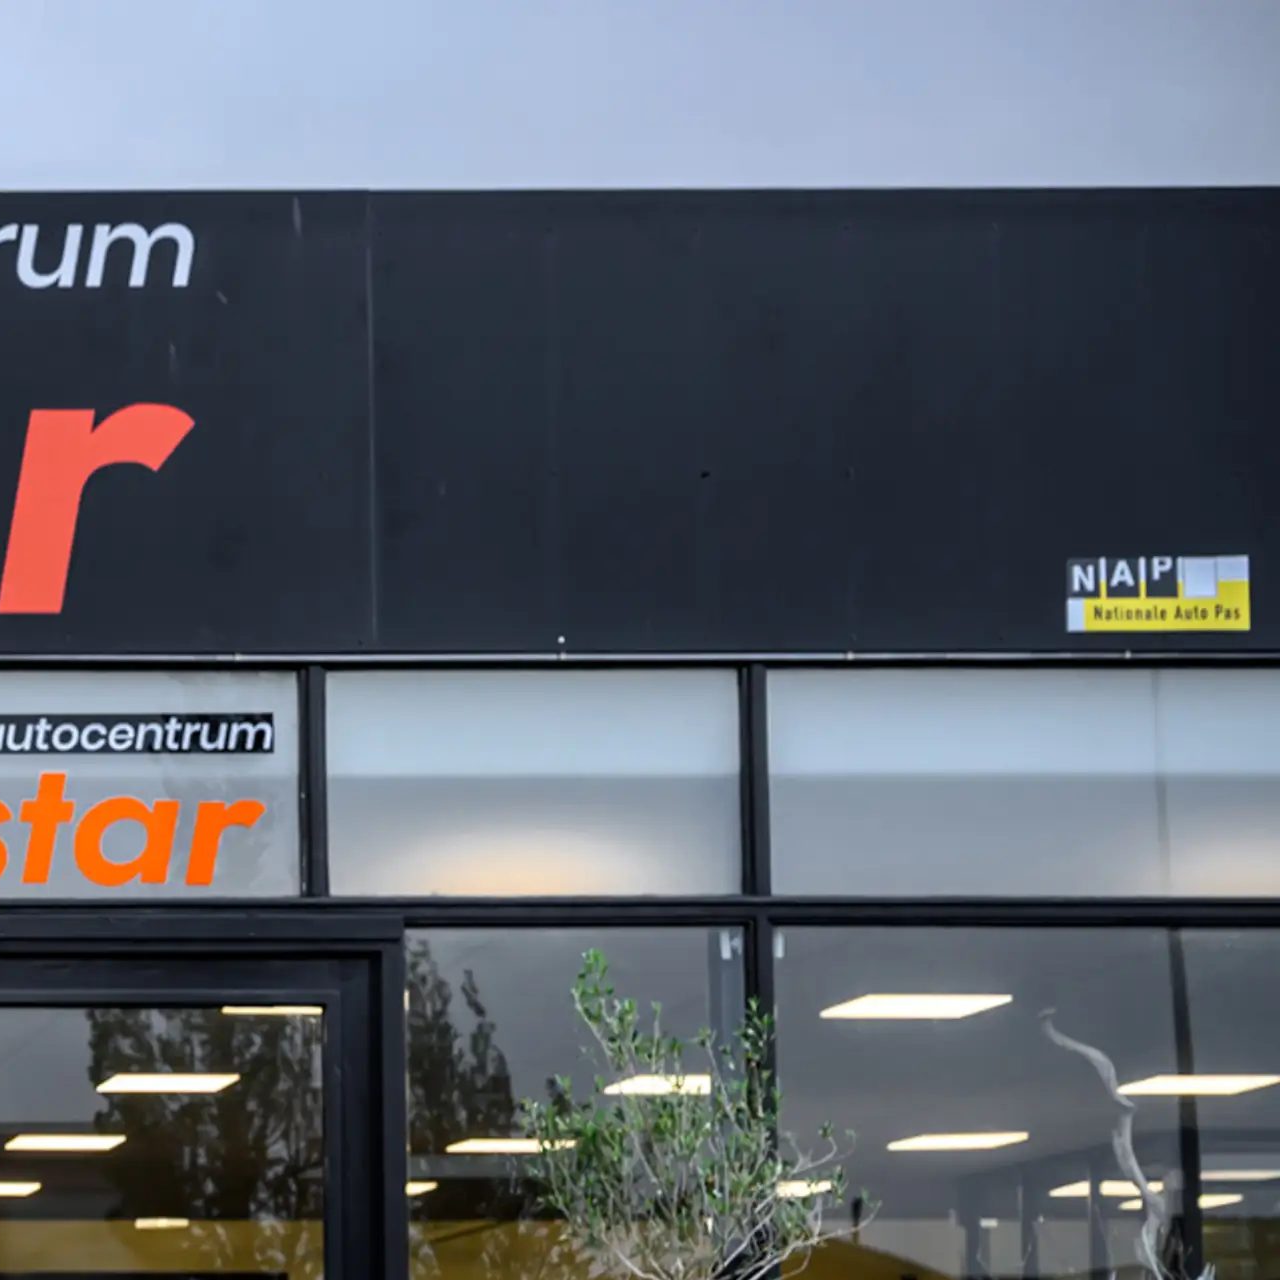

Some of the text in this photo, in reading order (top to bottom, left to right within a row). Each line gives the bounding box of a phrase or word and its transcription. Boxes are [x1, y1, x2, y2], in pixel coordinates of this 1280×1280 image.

[1094, 604, 1241, 621] Nationale Auto Pas
